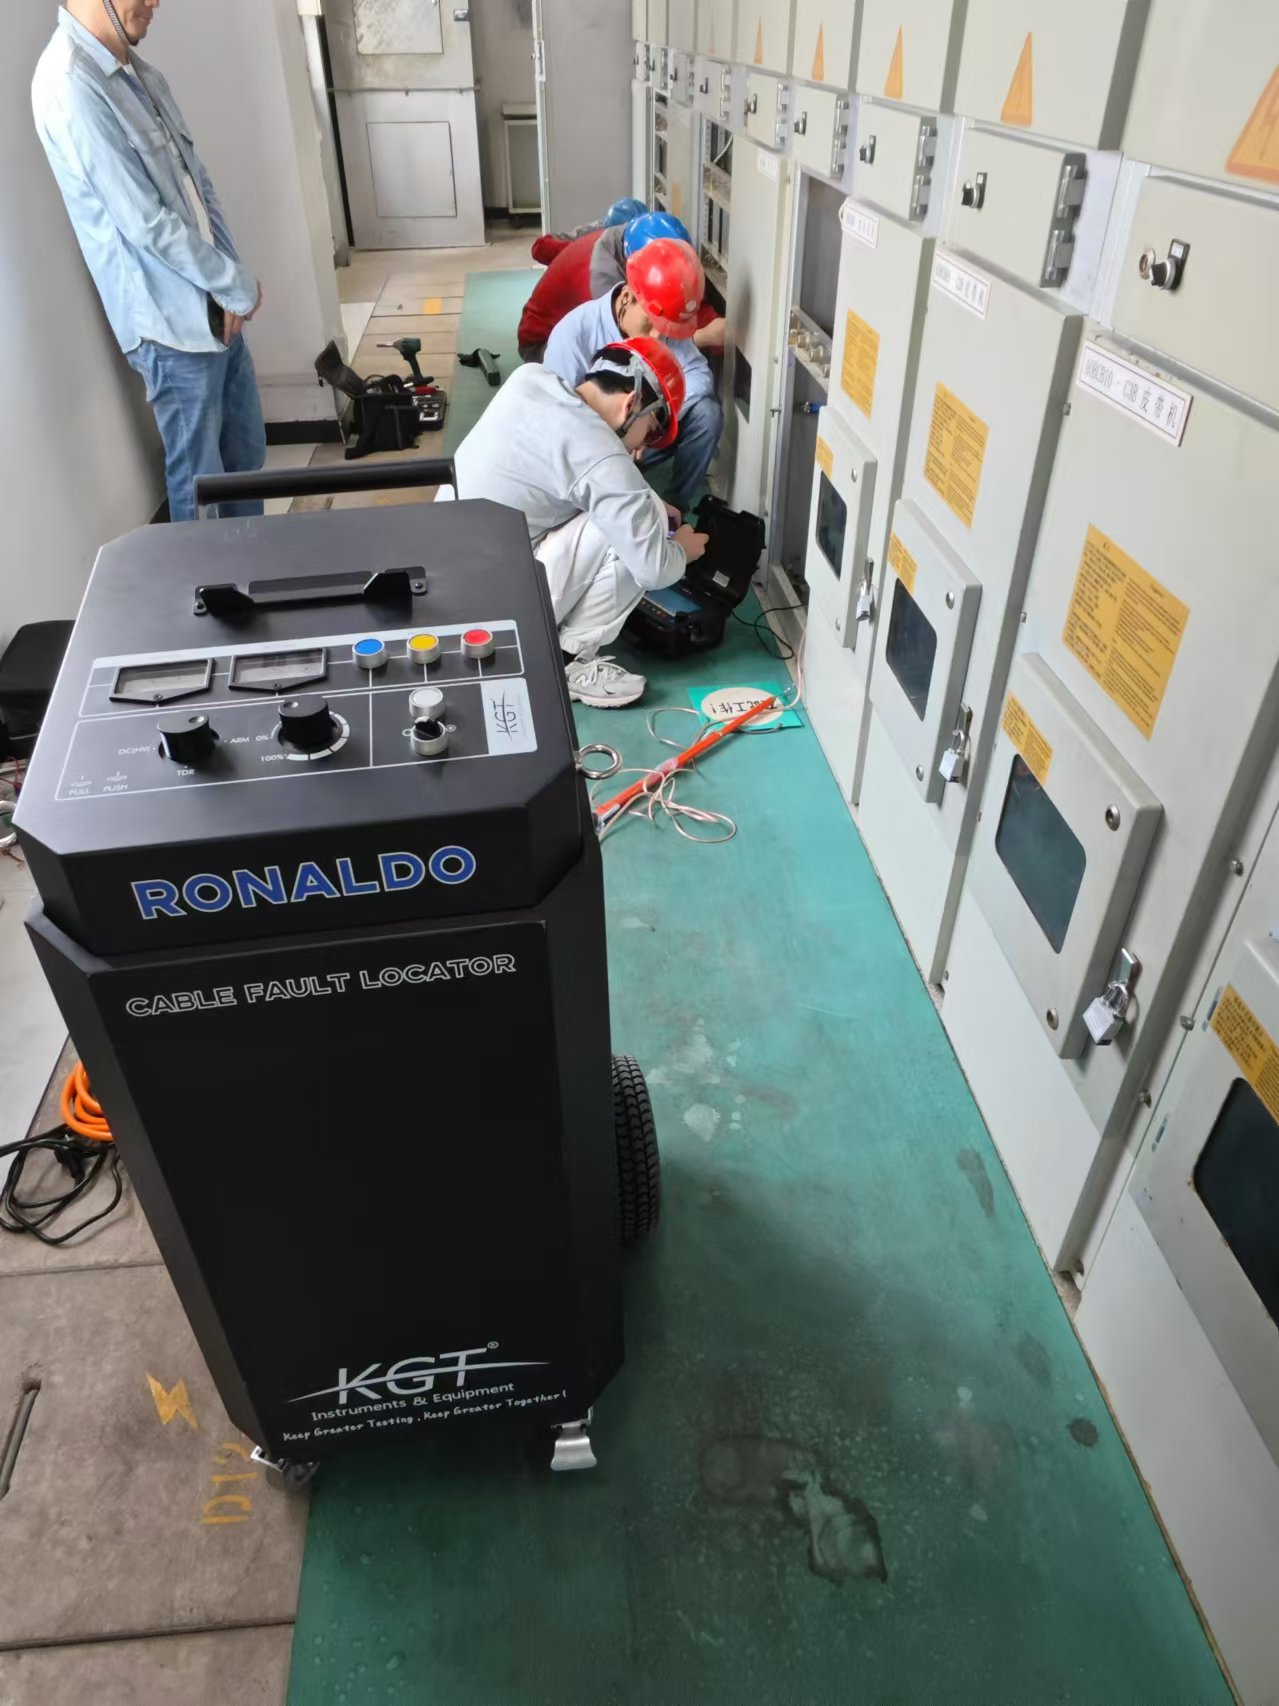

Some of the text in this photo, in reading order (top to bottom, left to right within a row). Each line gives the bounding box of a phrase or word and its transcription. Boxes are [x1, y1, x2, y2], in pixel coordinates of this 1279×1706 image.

[229, 735, 250, 744] ARM
[176, 768, 195, 777] TDR
[130, 845, 478, 921] RONALDO
[125, 953, 518, 1017] CABLE FAULT LOCATOR
[282, 1432, 311, 1442] Keep
[313, 1423, 365, 1437] Greater
[423, 1410, 451, 1420] Keep
[453, 1402, 503, 1416] Greater
[311, 1383, 515, 1422] Instruments & Equipment
